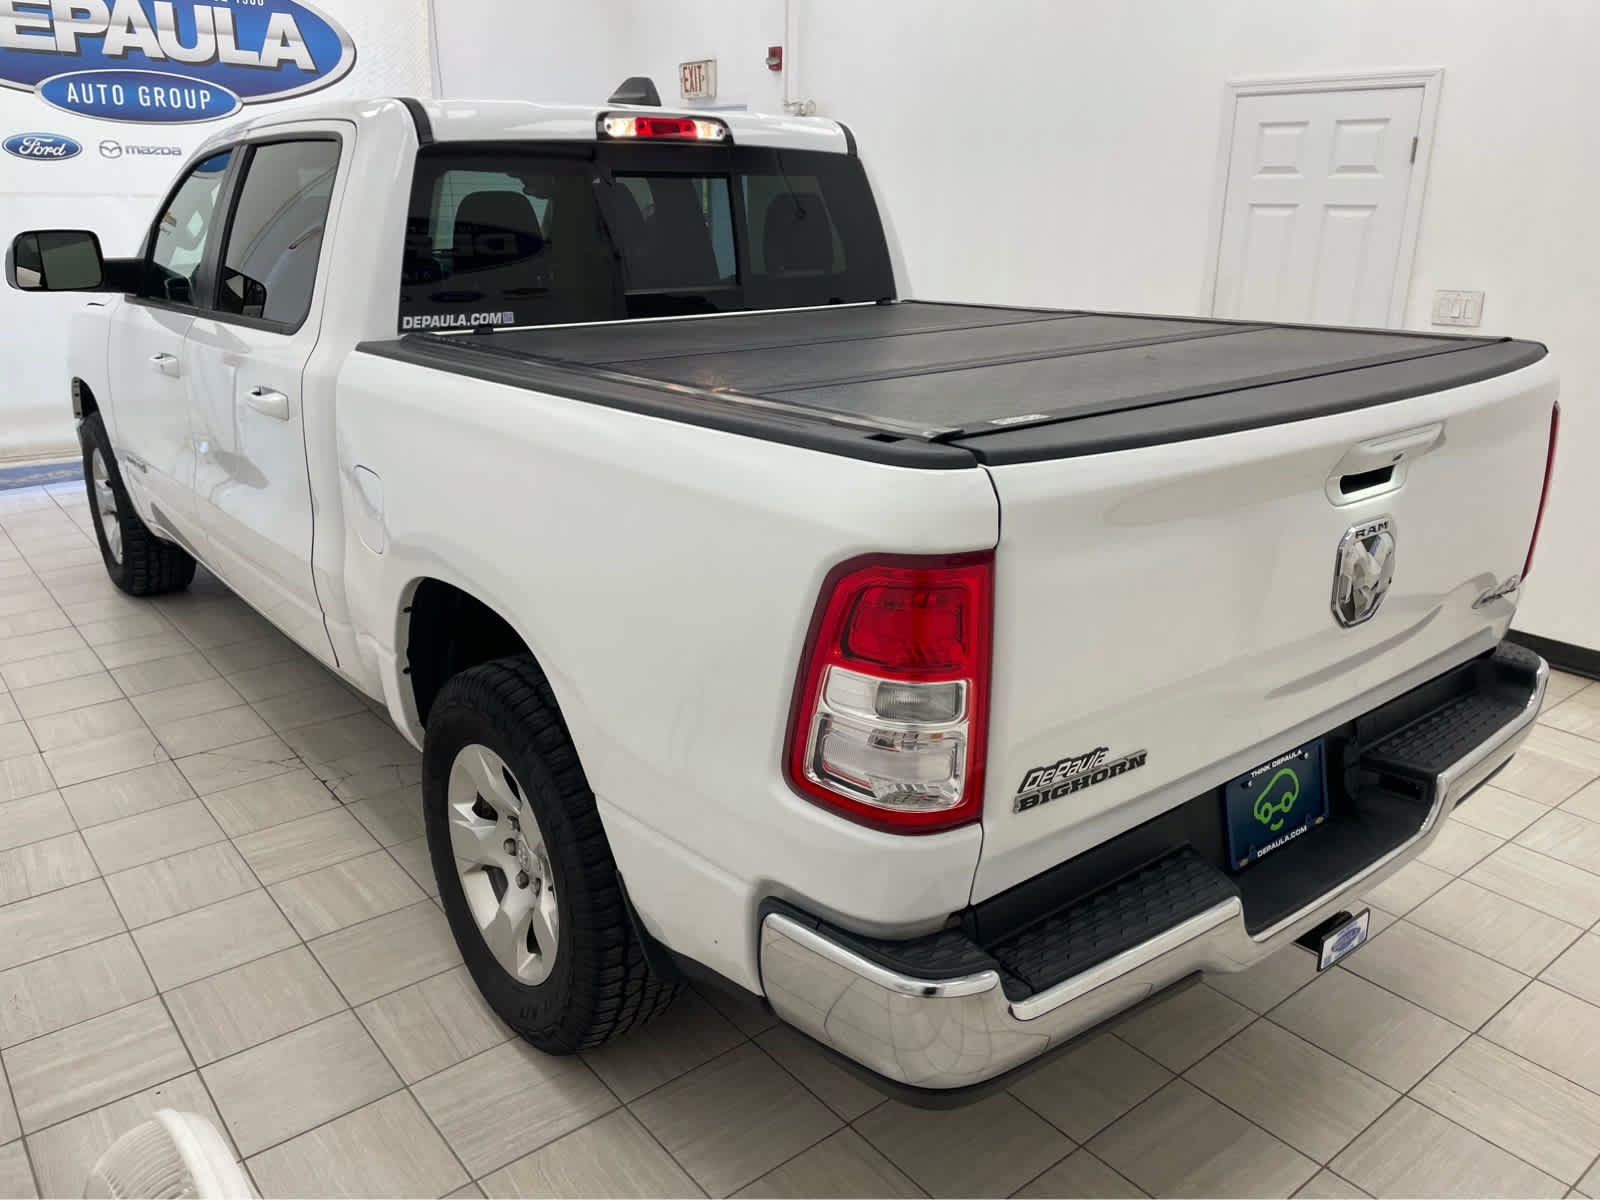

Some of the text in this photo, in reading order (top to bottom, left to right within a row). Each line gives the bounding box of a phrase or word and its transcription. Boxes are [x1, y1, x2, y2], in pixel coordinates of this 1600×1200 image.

[0, 0, 317, 71] EPAULA
[683, 64, 702, 92] EXIT
[67, 82, 211, 110] AUTO GROUP
[18, 136, 67, 156] Ford
[125, 144, 182, 156] mazda
[402, 312, 503, 329] DEPAULA.COM
[1354, 520, 1389, 539] RAM
[1250, 749, 1303, 778] THINK DEPAULA
[1013, 750, 1148, 814] BIGHORN
[1256, 825, 1308, 858] DEPAULA.COM
